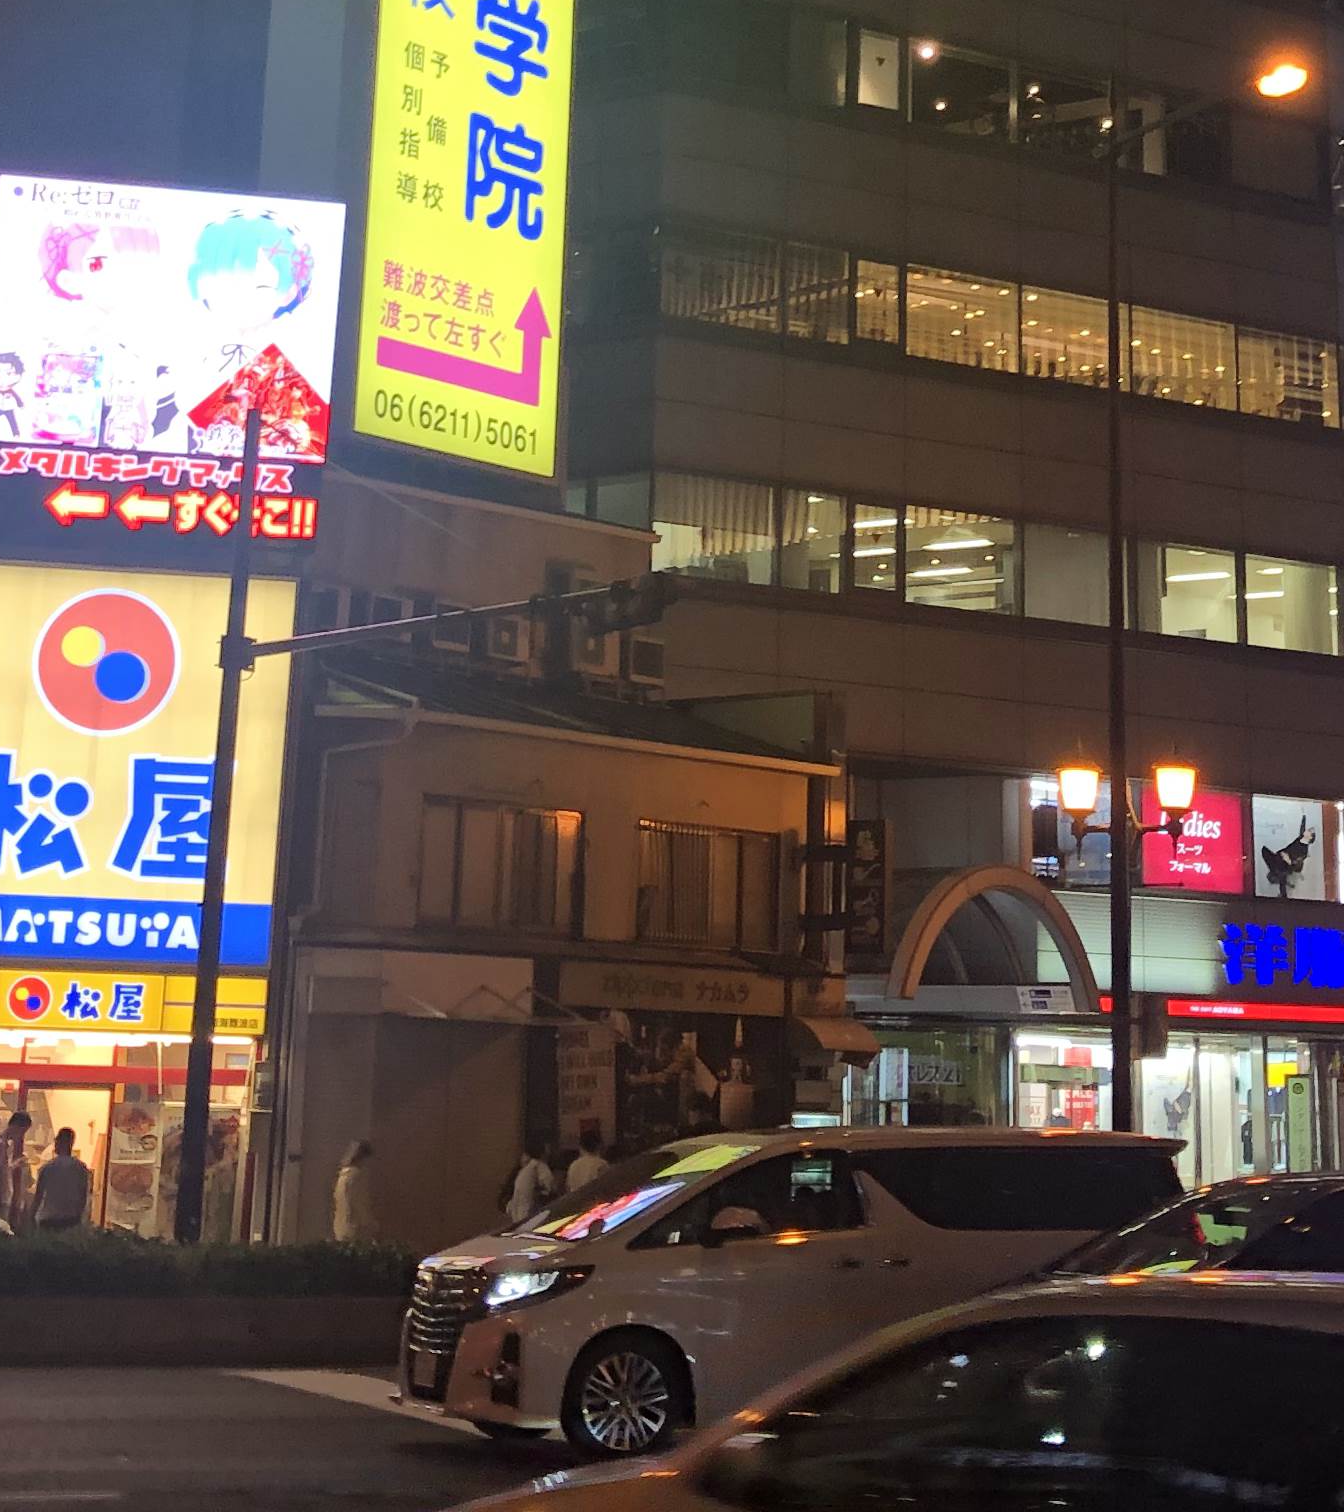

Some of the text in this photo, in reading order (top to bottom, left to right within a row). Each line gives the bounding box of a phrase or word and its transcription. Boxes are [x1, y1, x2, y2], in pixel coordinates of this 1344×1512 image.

[396, 40, 425, 212] 個別指導
[423, 50, 450, 213] 予備校
[383, 258, 496, 318] 難波交差点
[380, 297, 506, 359] 渡って左すぐ
[374, 389, 538, 456] 06(6211)5061
[174, 489, 320, 540] すぐこ!!
[1157, 810, 1222, 840] Ldies
[1176, 842, 1204, 856] スーツ
[1168, 859, 1212, 875] フォーマル
[60, 981, 146, 1023] 松屋
